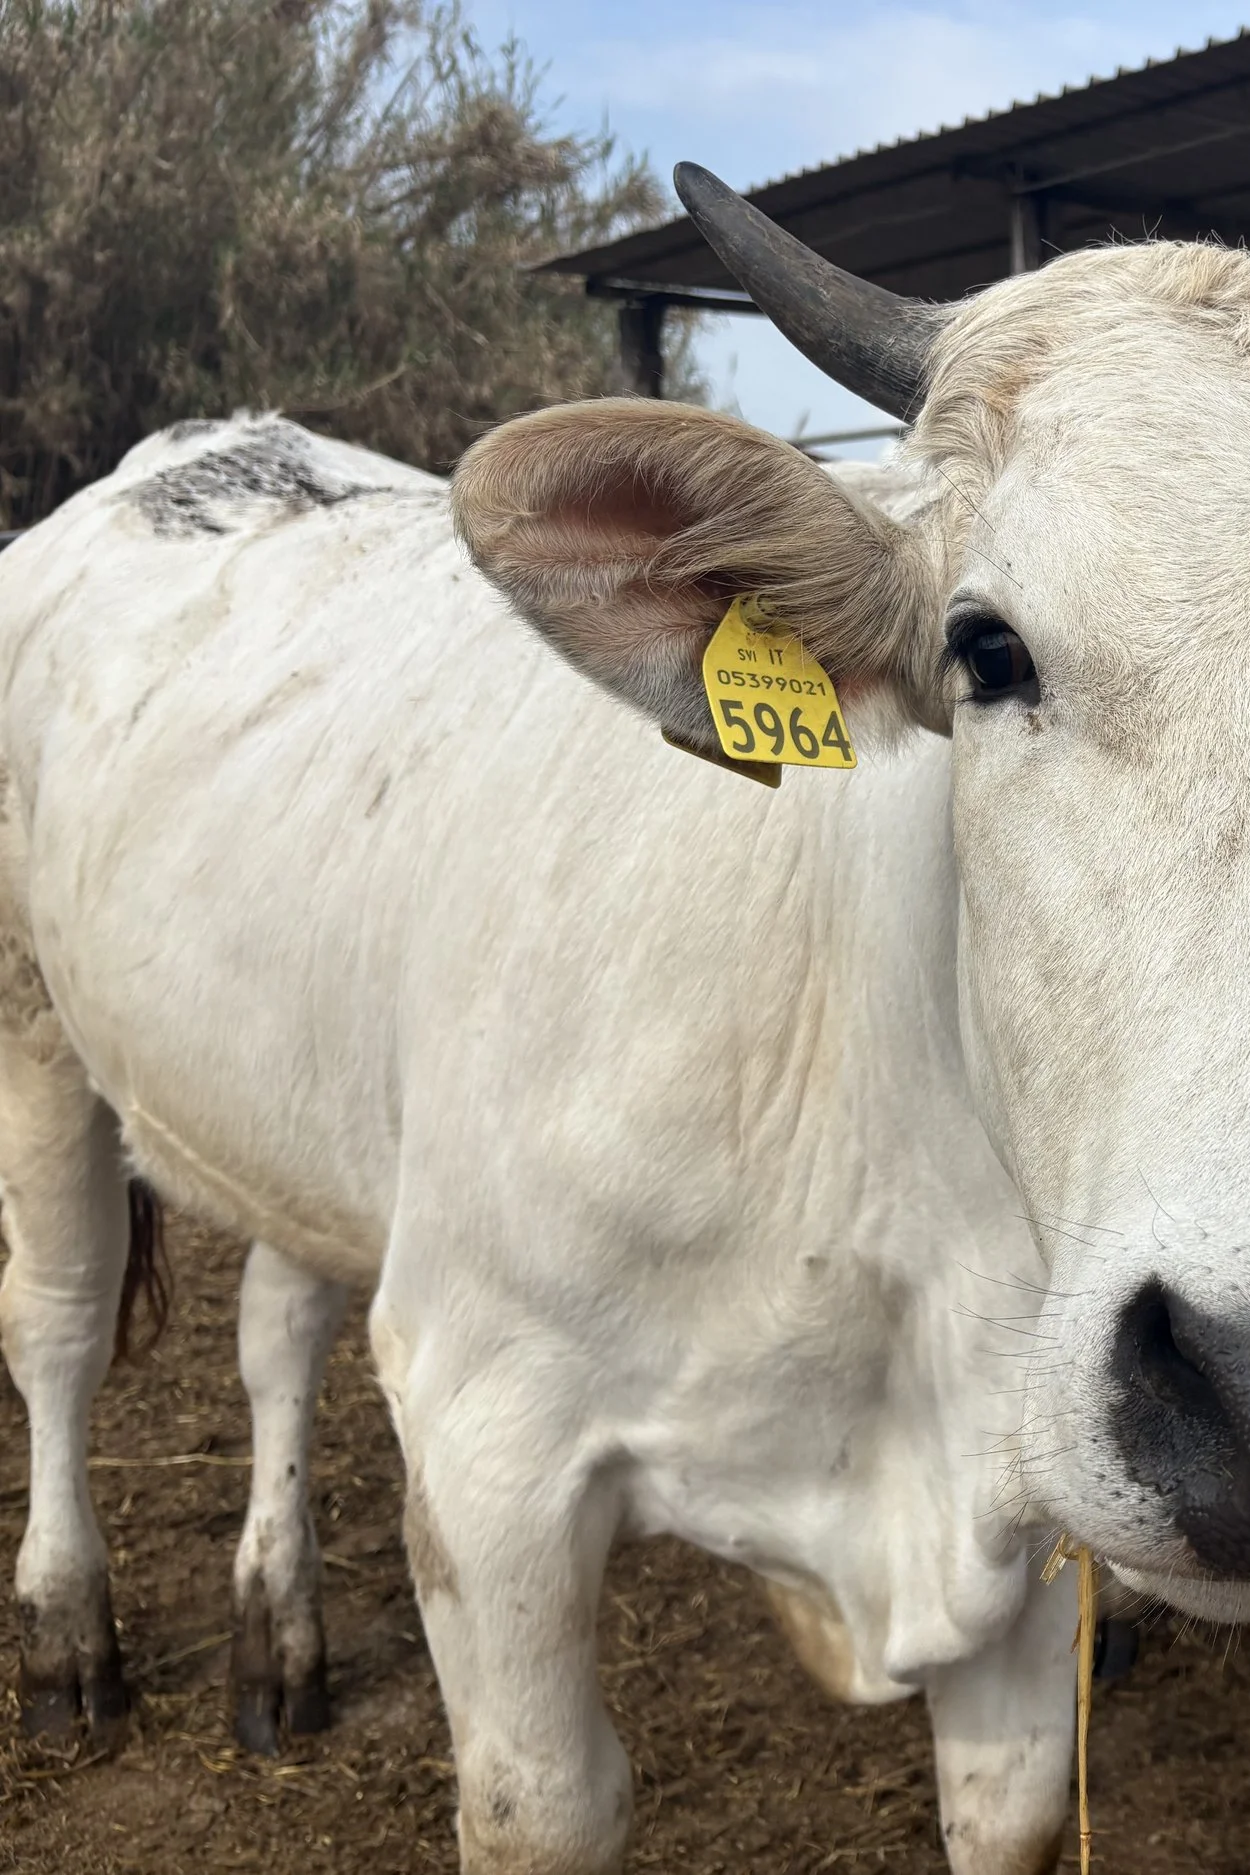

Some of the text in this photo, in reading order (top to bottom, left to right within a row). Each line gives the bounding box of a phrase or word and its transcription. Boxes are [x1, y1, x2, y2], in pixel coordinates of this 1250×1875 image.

[769, 648, 784, 665] IT
[717, 669, 826, 696] 05399021
[719, 699, 853, 762] 5964
